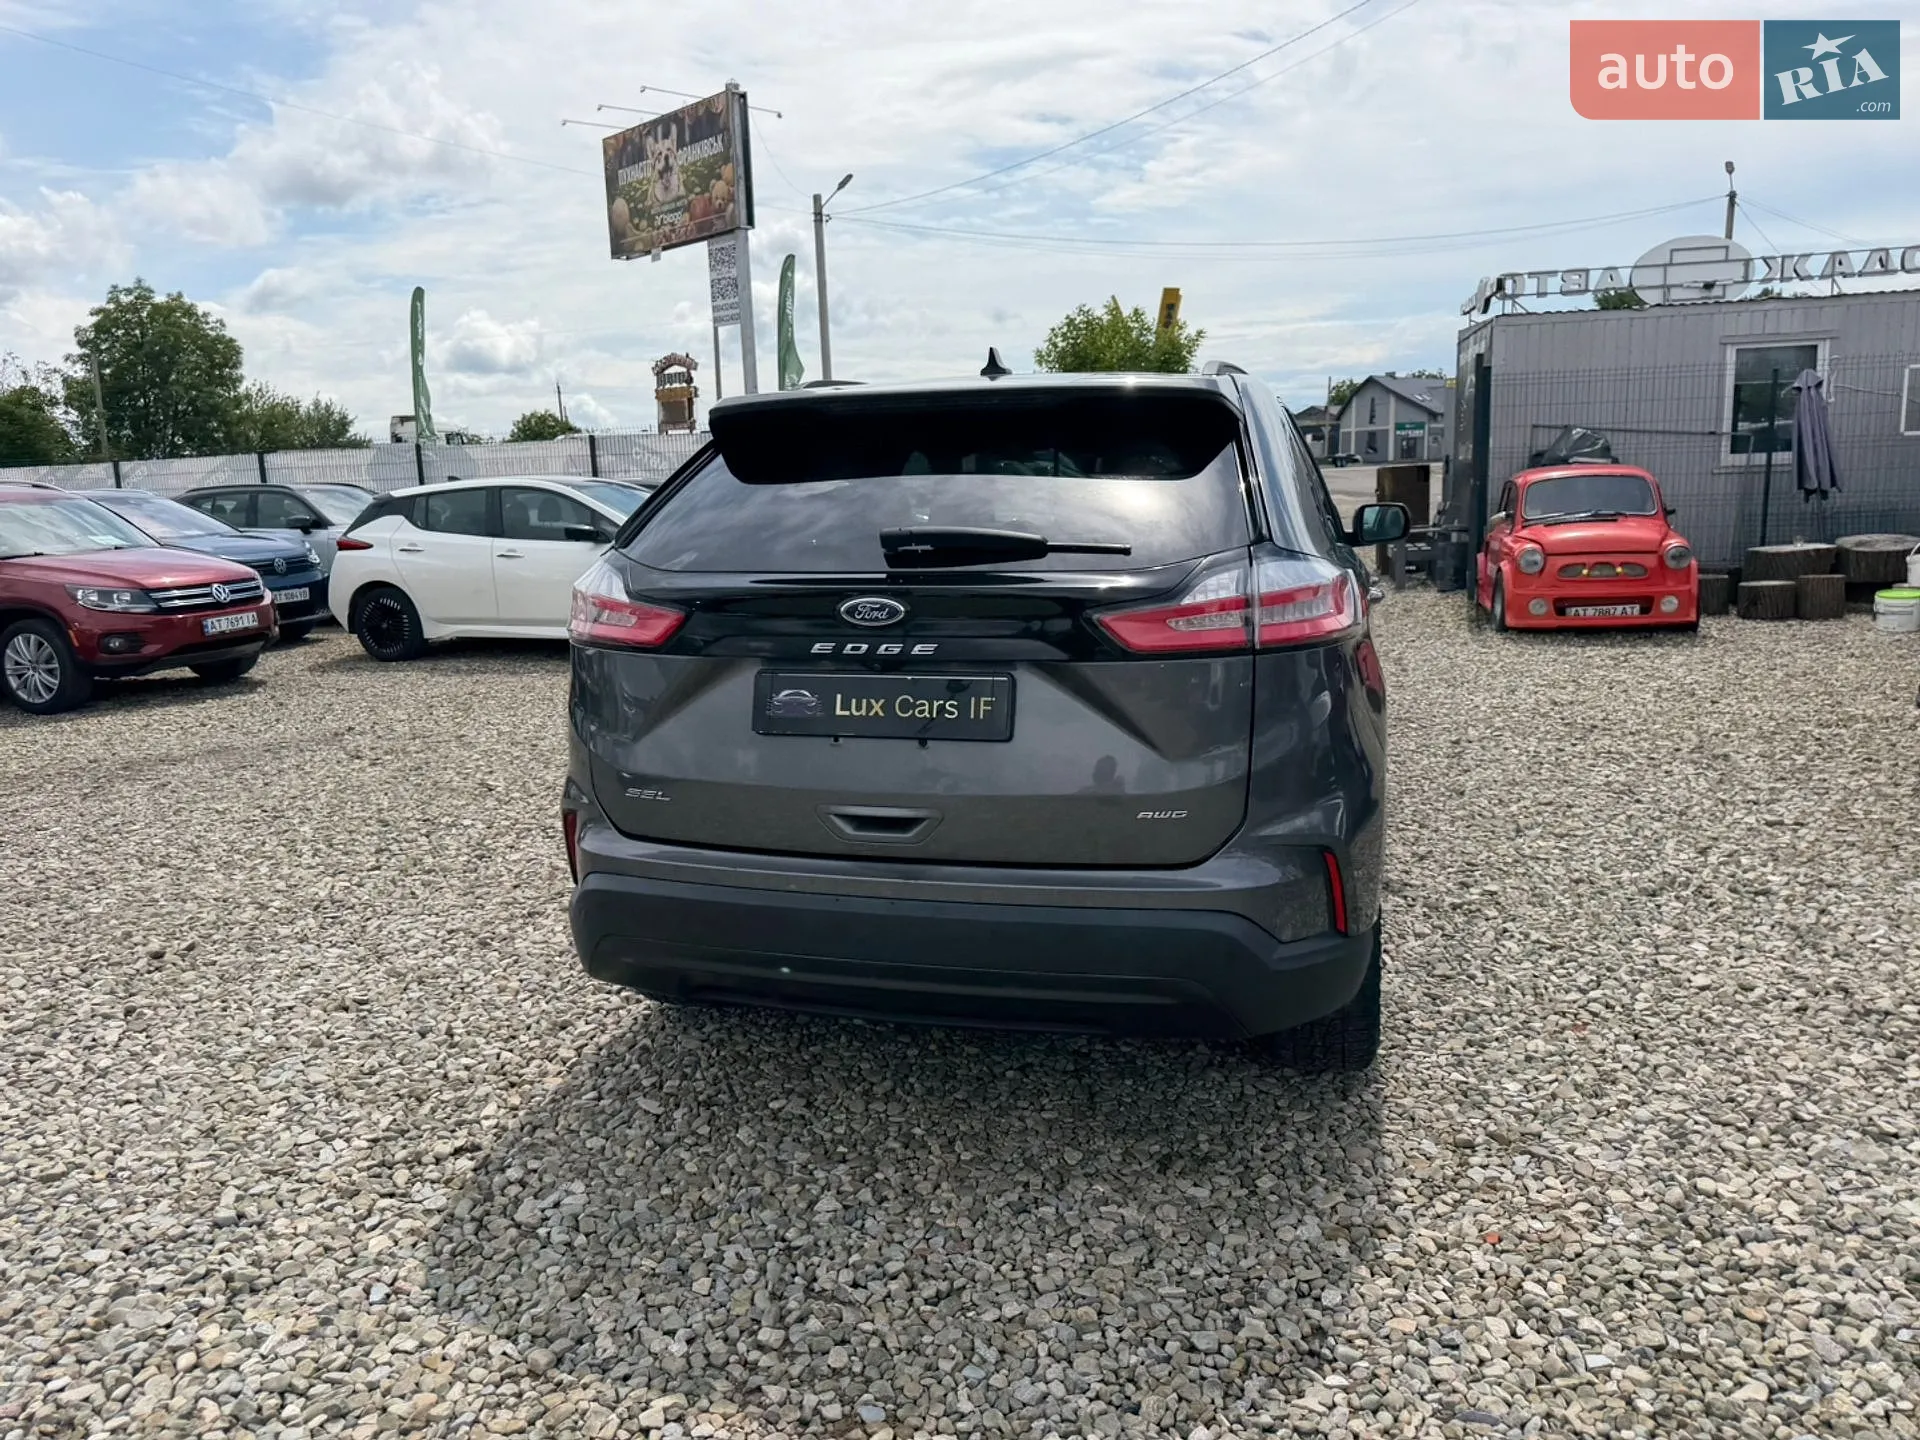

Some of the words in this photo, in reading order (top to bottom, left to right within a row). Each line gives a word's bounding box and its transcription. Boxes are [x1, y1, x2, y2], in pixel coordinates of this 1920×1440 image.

[854, 602, 890, 621] Ford
[1573, 607, 1588, 617] AT
[1620, 606, 1637, 616] AT
[210, 619, 223, 631] AT
[225, 616, 244, 628] 7691
[810, 642, 939, 655] EDGE
[835, 693, 885, 717] Lux
[894, 694, 959, 719] Cars
[970, 696, 996, 720] IF
[625, 787, 672, 801] SEL
[1136, 810, 1188, 819] AWD
